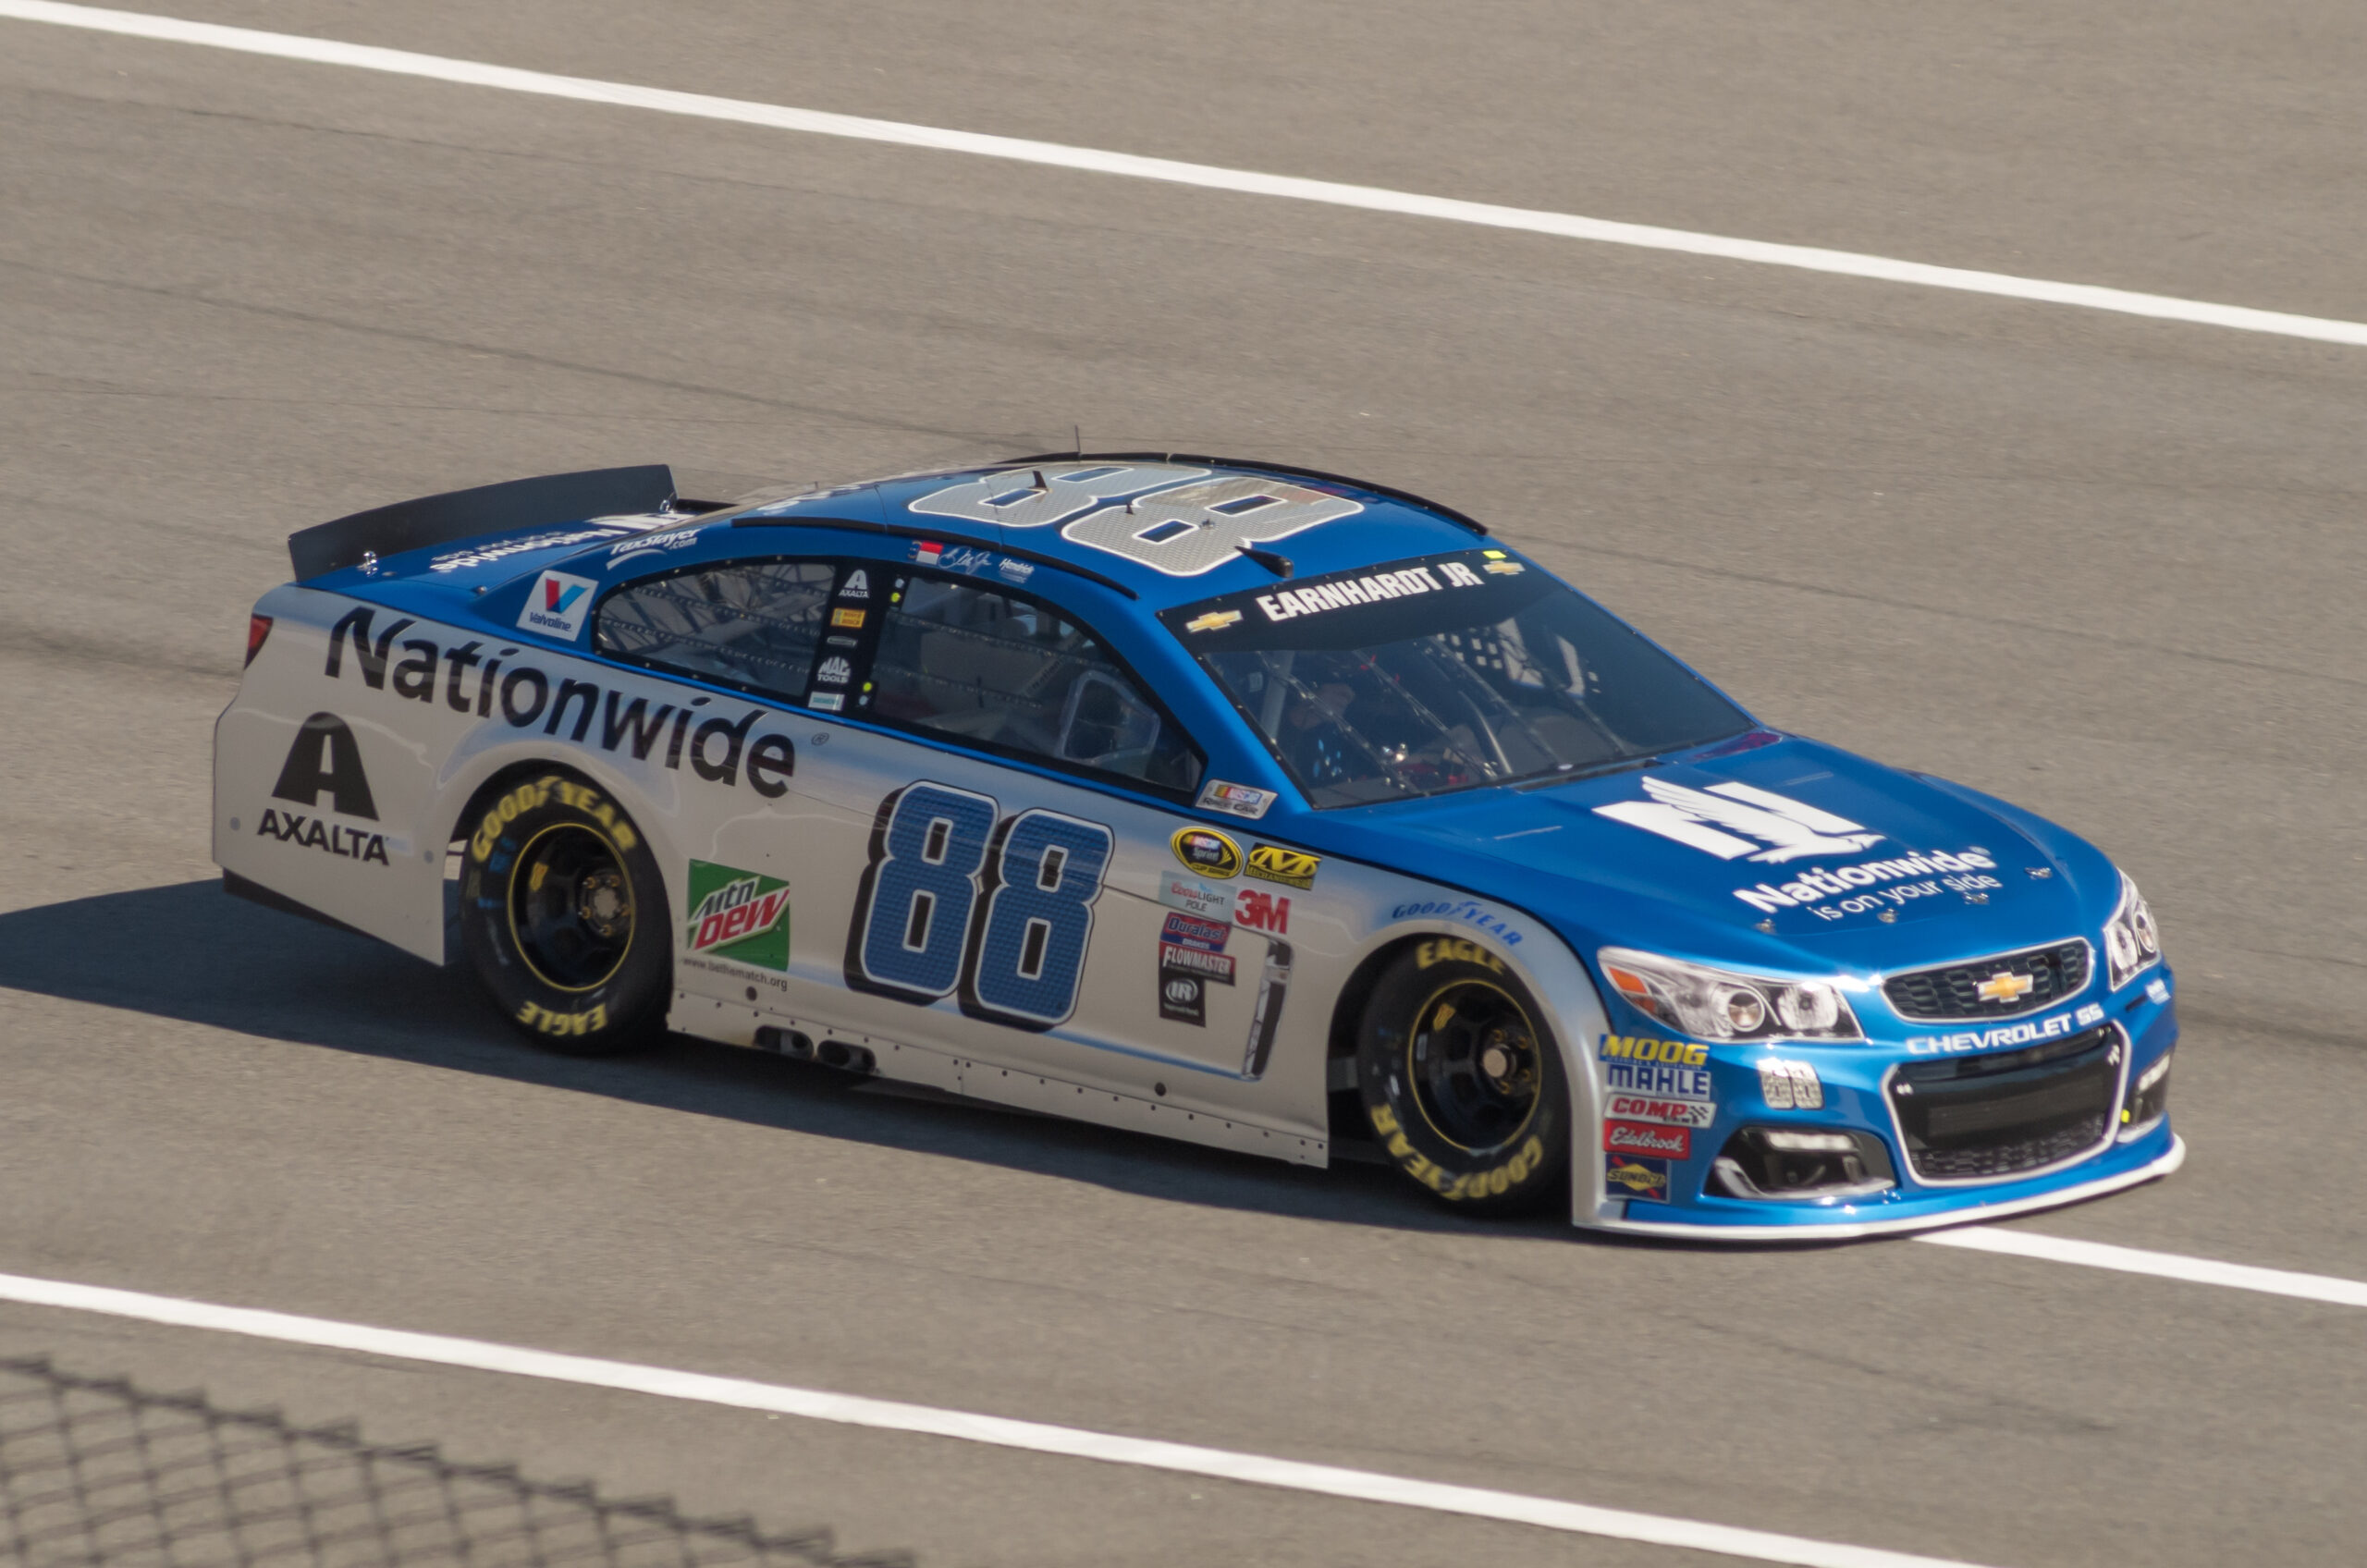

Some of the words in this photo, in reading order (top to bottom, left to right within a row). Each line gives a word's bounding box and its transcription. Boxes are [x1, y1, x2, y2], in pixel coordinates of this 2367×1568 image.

[908, 460, 1366, 577] 88
[838, 589, 870, 599] AXALTA
[1255, 567, 1443, 622] EARNHARDT
[1437, 561, 1485, 587] JR
[529, 610, 573, 632] Valvoline
[817, 673, 850, 684] TOOLS
[818, 655, 851, 677] MAC
[324, 606, 796, 799] Nationwide
[257, 808, 390, 866] AXALTA
[1197, 891, 1226, 906] LIGHT
[1732, 849, 1997, 914] Nationwide
[1806, 905, 1844, 922] is
[1839, 891, 1885, 913] on
[1876, 879, 1944, 906] your
[1942, 872, 2004, 893] side
[843, 778, 1115, 1034] 88
[1185, 899, 1208, 913] POLE
[1234, 888, 1292, 936] 3M
[1168, 916, 1226, 941] Duralast
[1392, 900, 1524, 948] GOODYEAR
[1162, 945, 1233, 975] FLOWMASTER
[1416, 938, 1506, 975] EAGLE
[681, 956, 788, 993] www.bethematch.org
[1906, 1013, 2072, 1055] CHEVROLET
[2076, 1002, 2105, 1026] SS
[1601, 1035, 1710, 1066] MOOG
[1608, 1064, 1709, 1096] MAHLE
[1612, 1096, 1688, 1118] COMP
[1610, 1126, 1685, 1153] Edelbrock
